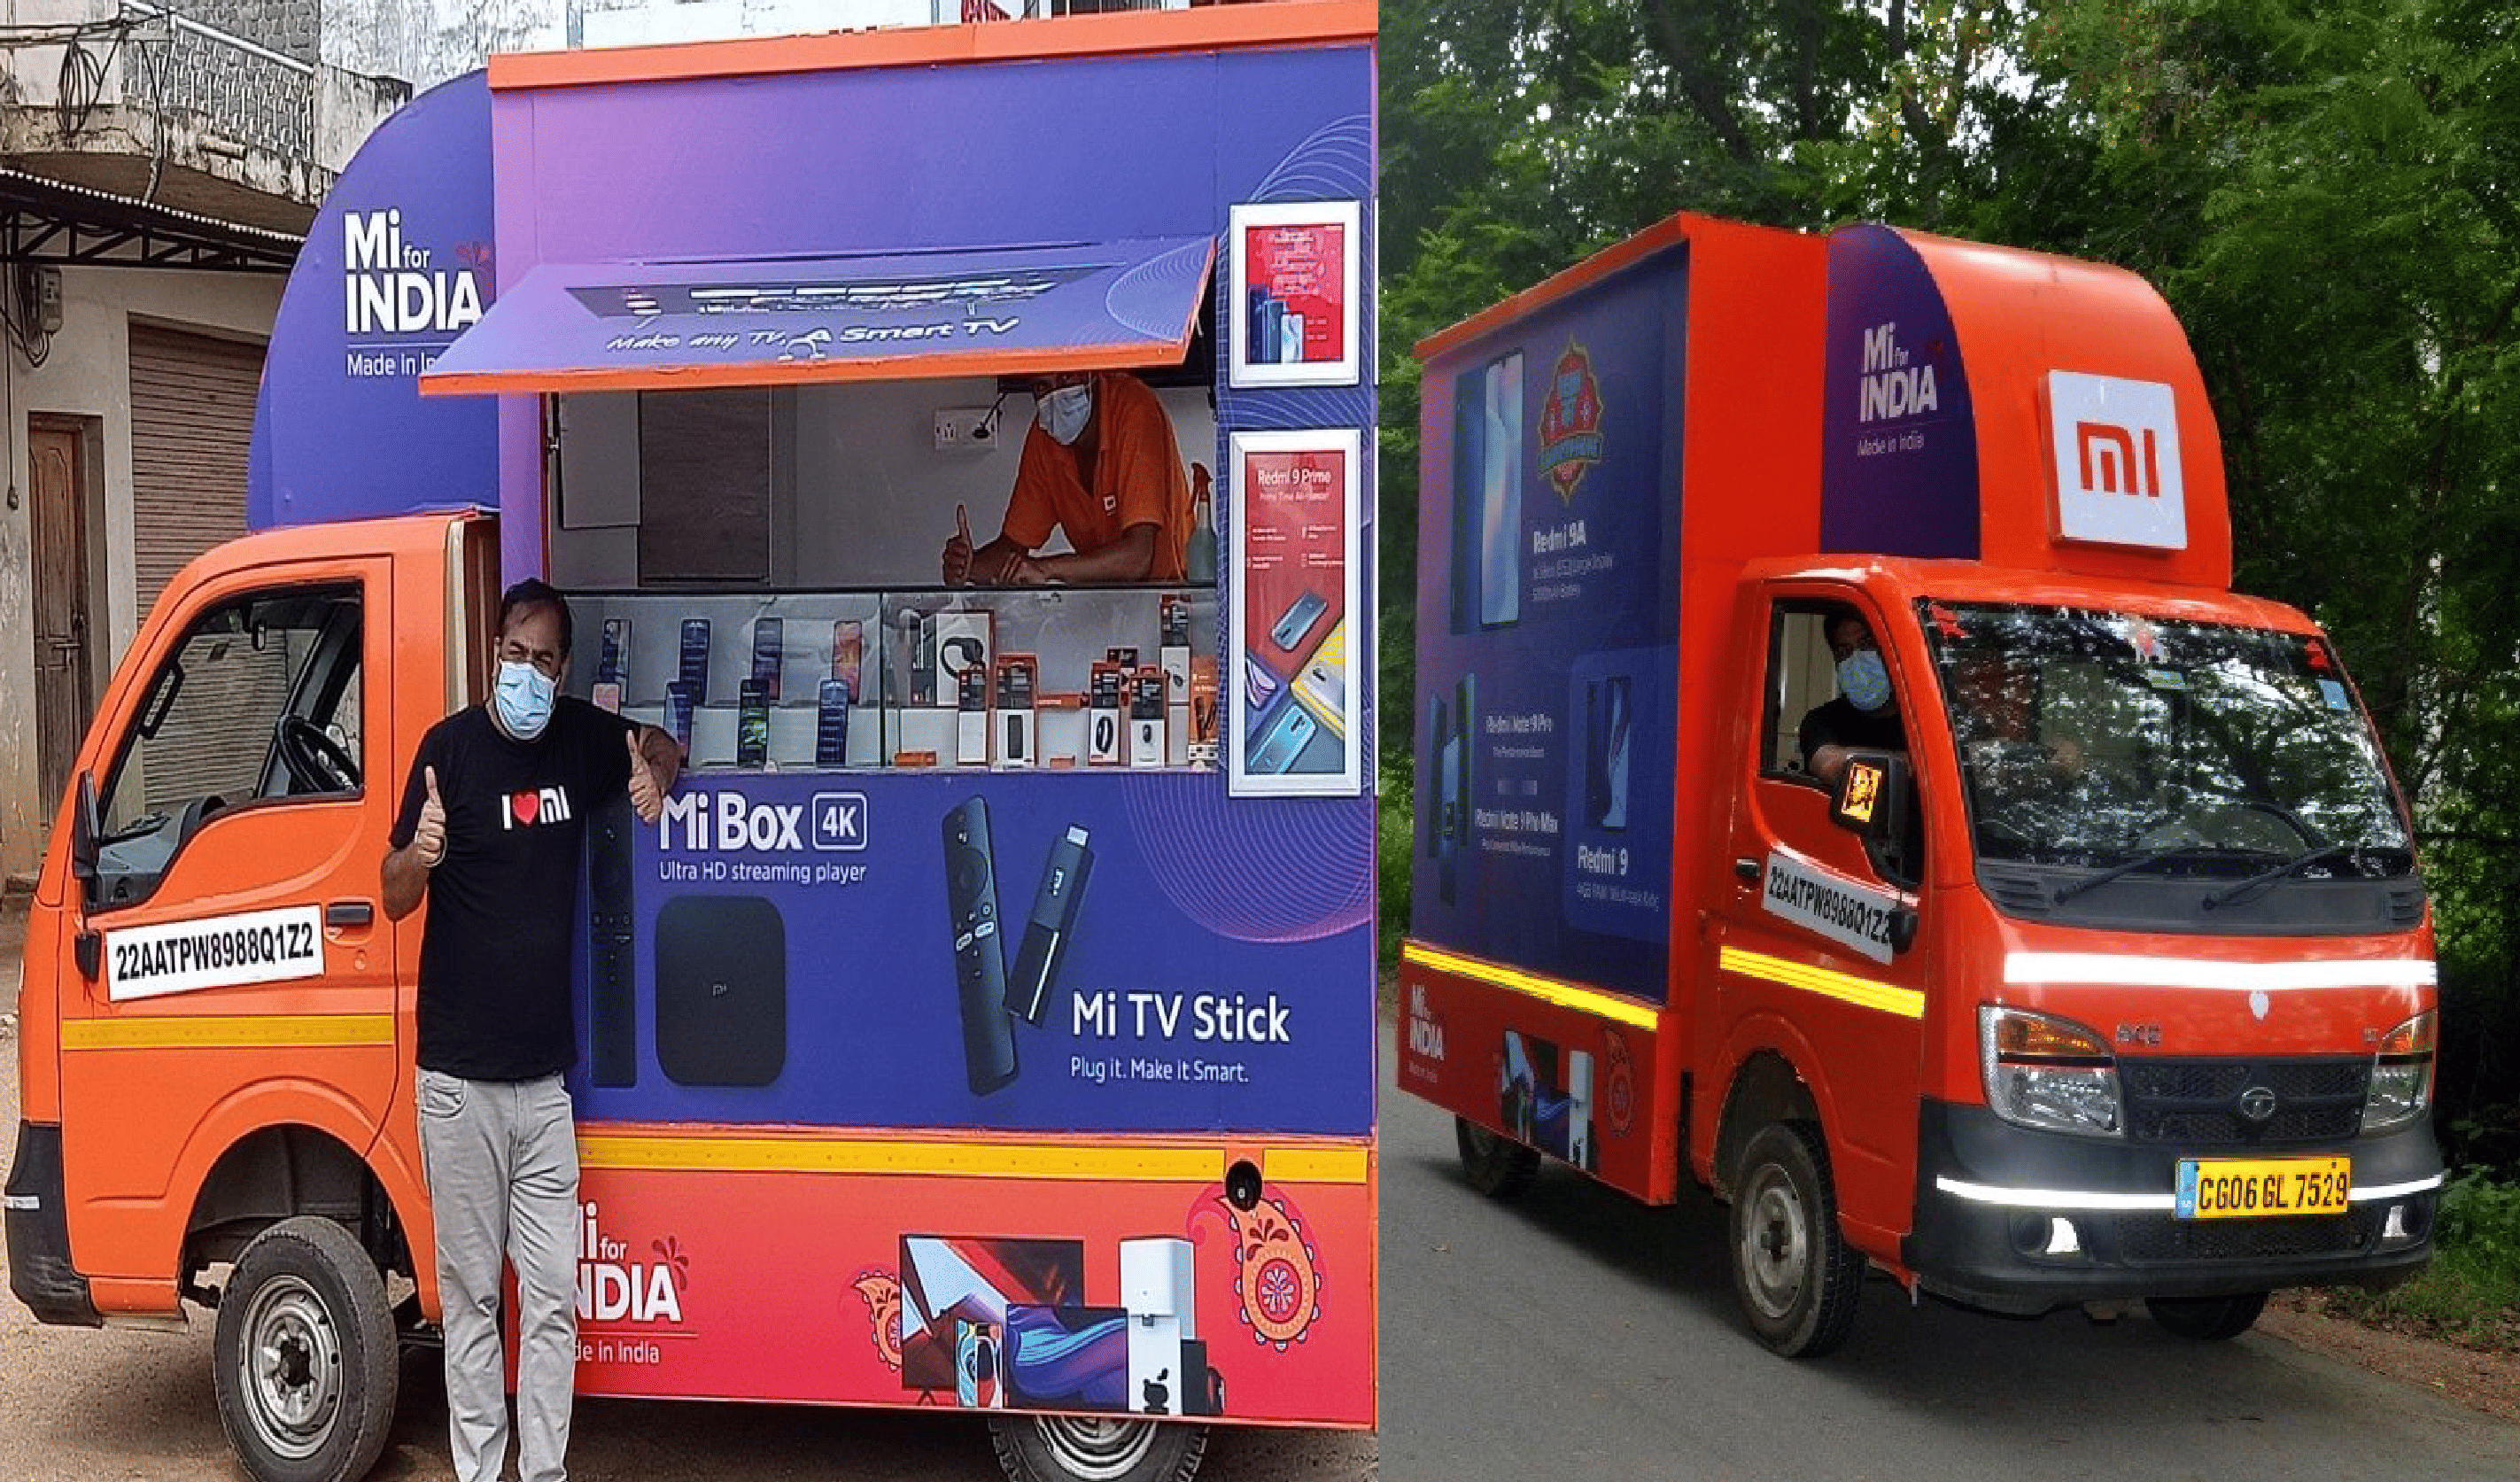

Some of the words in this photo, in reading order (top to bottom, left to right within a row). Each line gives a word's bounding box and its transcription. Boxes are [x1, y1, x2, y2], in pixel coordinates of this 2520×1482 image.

[345, 208, 400, 268] Mi
[404, 244, 430, 268] for
[346, 271, 484, 332] INDIA
[841, 323, 954, 343] Smart
[964, 317, 1020, 337] TV
[1864, 322, 1896, 372] Mi
[347, 353, 396, 376] Made
[1860, 365, 1937, 423] INDIA
[1292, 469, 1300, 485] 9
[659, 791, 709, 850] Mi
[717, 791, 803, 850] Box
[821, 805, 857, 838] 4K
[660, 860, 698, 881] Ultra
[702, 861, 727, 881] HD
[731, 860, 810, 885] streaming
[815, 861, 867, 885] player
[1578, 845, 1615, 875] Redmi
[1620, 847, 1629, 876] 9
[116, 922, 314, 982] 22AATPW8988Q1Z2
[1072, 989, 1116, 1037] Mi
[1127, 992, 1183, 1038] TV
[1194, 994, 1291, 1043] Stick
[1071, 1056, 1105, 1083] Plug
[1130, 1058, 1174, 1081] Make
[1194, 1059, 1250, 1083] Smart.
[2198, 1174, 2258, 1210] CG06
[2262, 1174, 2289, 1208] GL
[2295, 1171, 2348, 1208] 7529
[600, 1235, 626, 1261] for
[576, 1263, 682, 1322] NDIA
[617, 1340, 660, 1363] India
